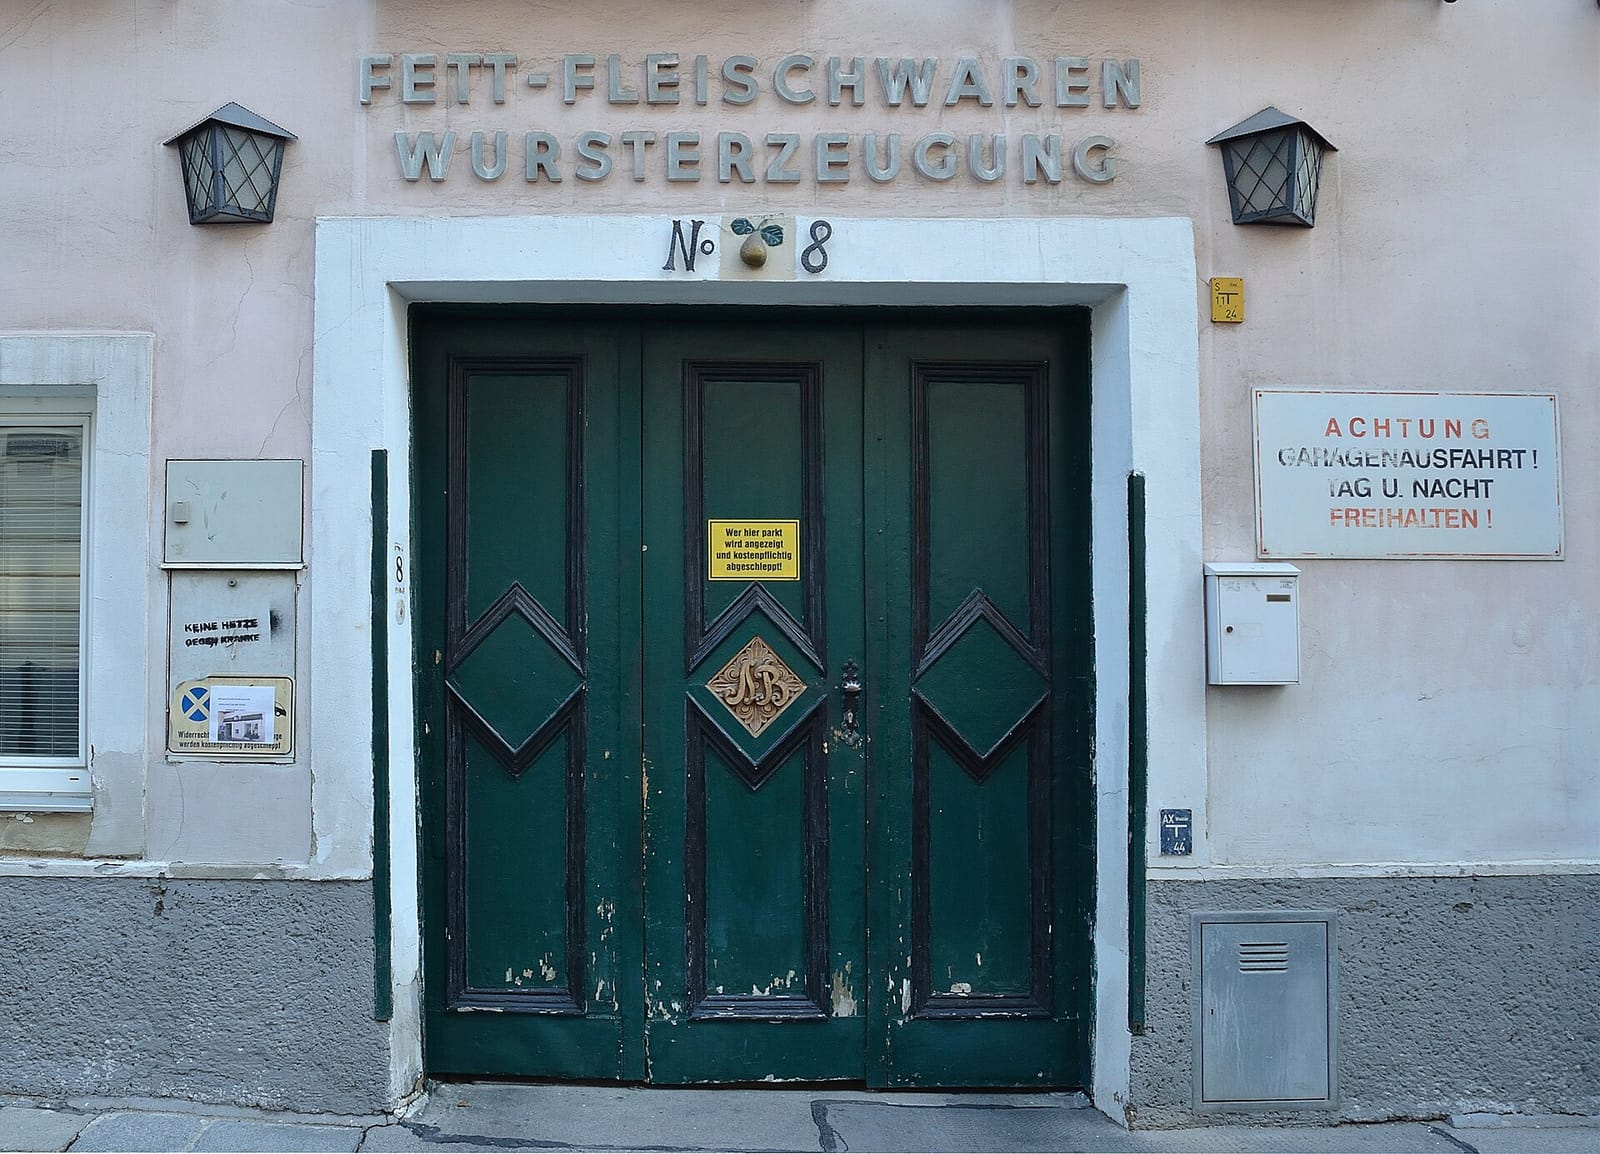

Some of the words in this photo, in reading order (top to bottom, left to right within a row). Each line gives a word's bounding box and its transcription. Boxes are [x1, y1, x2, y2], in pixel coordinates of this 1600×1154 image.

[359, 53, 1142, 109] FETT-FLEISCHWAREN
[394, 130, 1118, 184] WURSTERZEUGUNG
[801, 220, 832, 273] 8
[1215, 282, 1221, 291] S
[1226, 309, 1237, 319] 24
[1324, 417, 1489, 439] ACHTUNG
[1328, 477, 1372, 498] TAG
[1382, 478, 1403, 498] U.
[1412, 478, 1494, 499] NACHT
[725, 528, 741, 537] Wer
[744, 528, 759, 537] hier
[762, 528, 783, 538] parkt
[725, 540, 742, 549] wird
[745, 540, 783, 549] angezeigt
[716, 551, 731, 560] und
[733, 551, 792, 561] kostenpflichtig
[726, 562, 783, 572] abgeschleppt!
[184, 622, 218, 633] KEINE
[179, 740, 200, 748] werden
[1163, 814, 1175, 824] AX
[1174, 841, 1186, 851] 44
